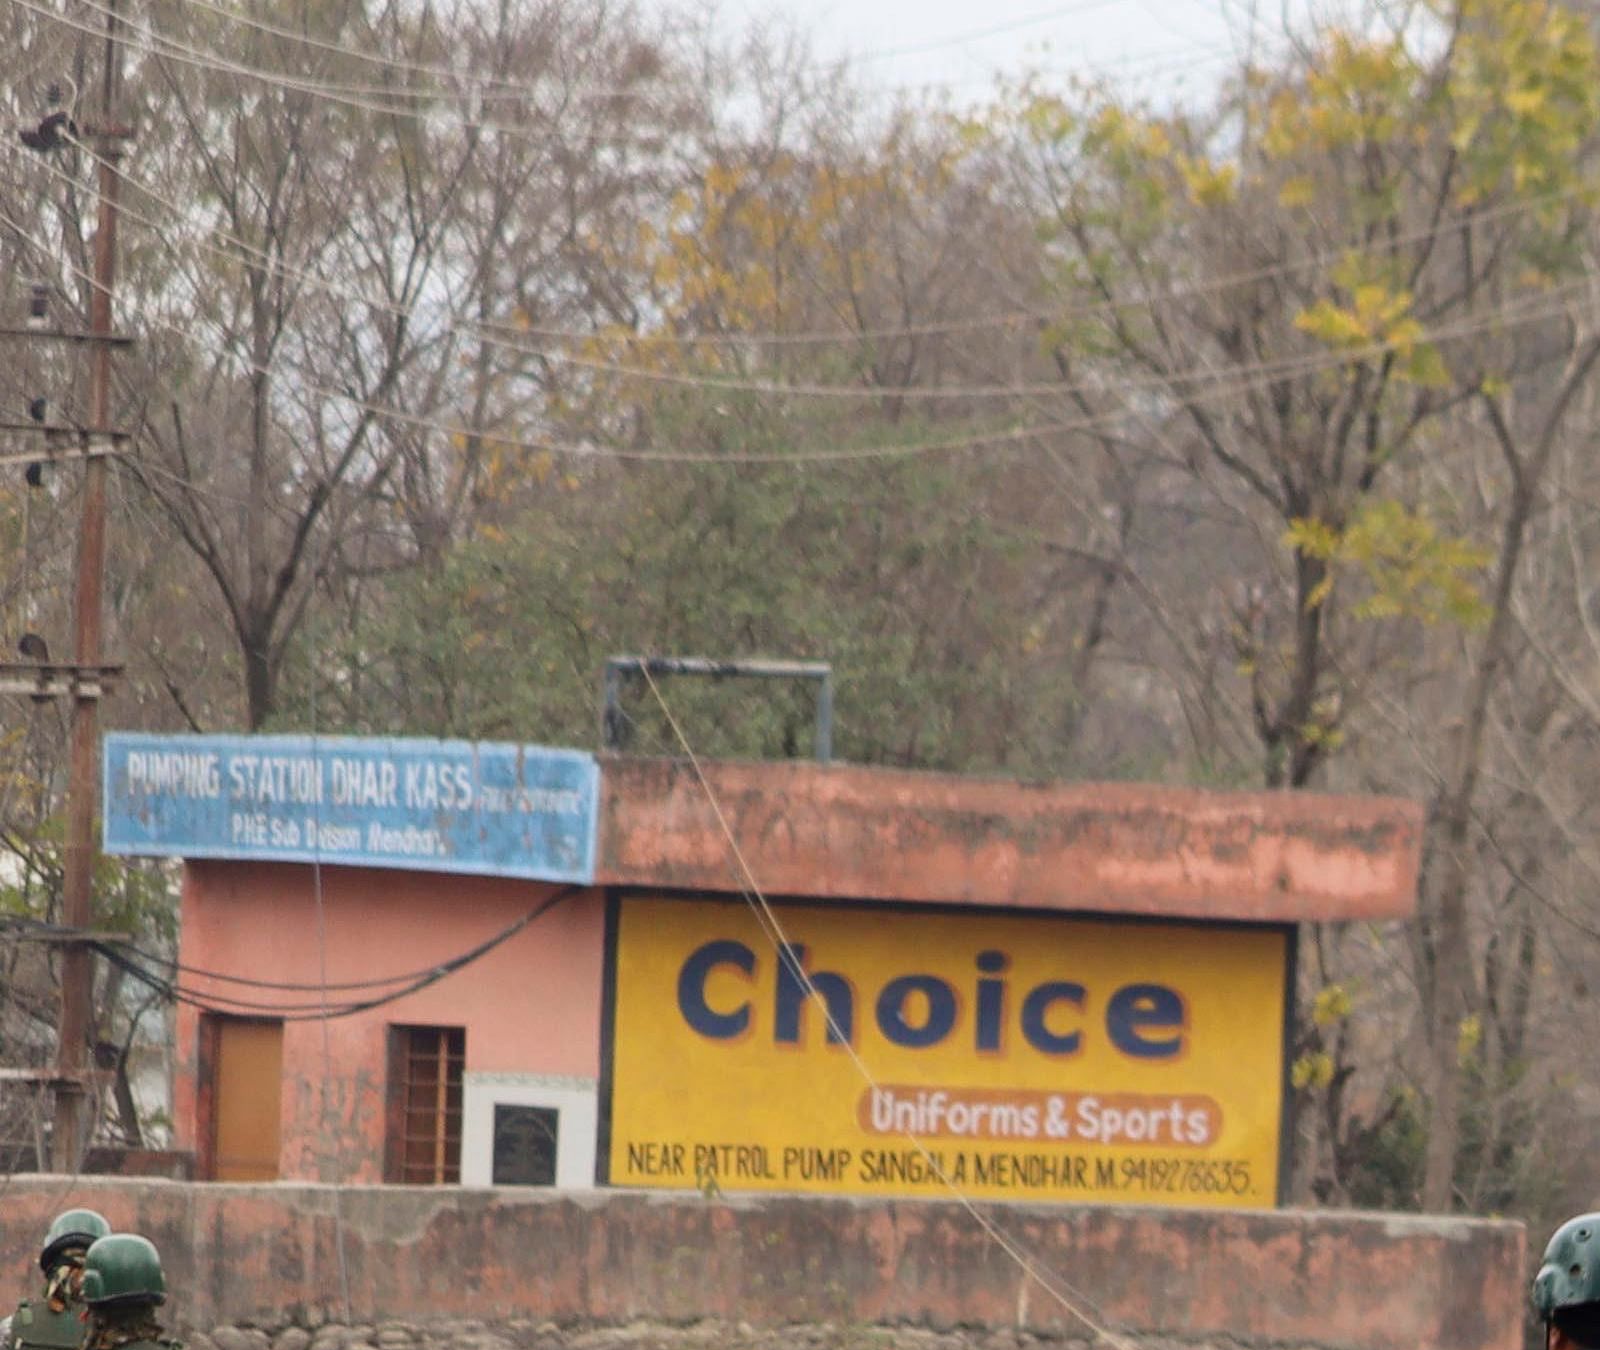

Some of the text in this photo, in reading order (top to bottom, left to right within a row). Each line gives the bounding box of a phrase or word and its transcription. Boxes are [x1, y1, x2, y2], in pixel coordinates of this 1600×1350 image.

[127, 752, 220, 797] PUMPING
[230, 755, 324, 804] STATION
[332, 758, 398, 808] DHAR
[404, 761, 473, 812] KASS
[677, 938, 1187, 1060] Choice
[870, 1088, 1210, 1145] Uniforms & Sports
[627, 1142, 686, 1176] NEAR
[694, 1143, 777, 1180] PATROL
[784, 1146, 852, 1182] PUMP
